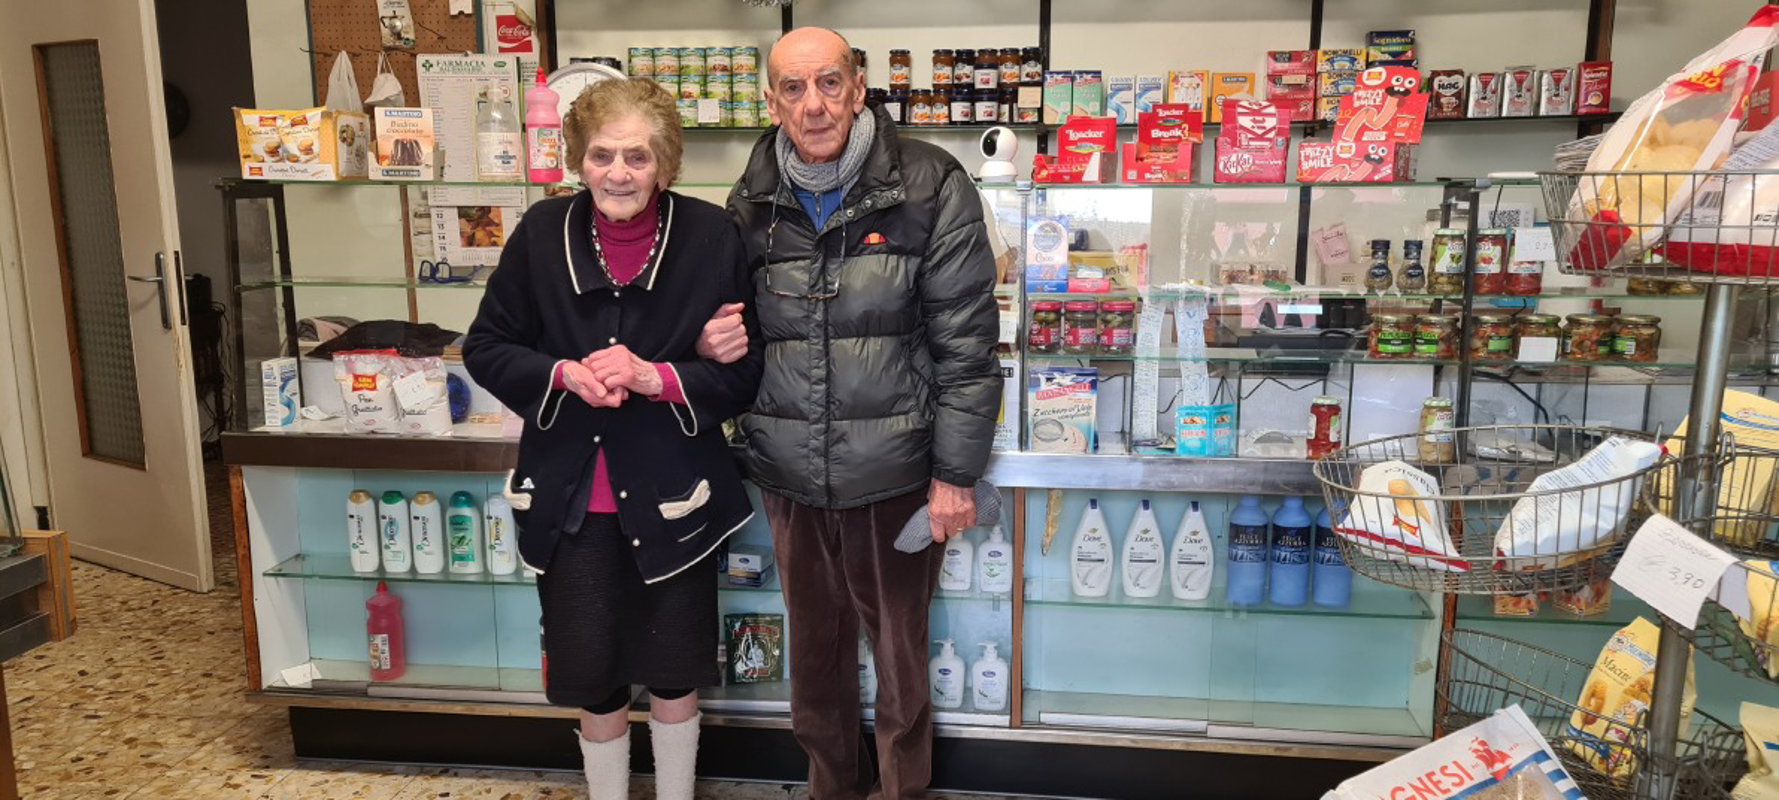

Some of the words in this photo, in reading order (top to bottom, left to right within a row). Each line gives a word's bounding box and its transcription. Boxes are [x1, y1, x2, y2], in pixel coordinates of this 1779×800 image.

[436, 60, 486, 68] FARMACIA
[1066, 130, 1105, 141] Loacker
[1151, 128, 1182, 139] Break
[1083, 534, 1102, 542] Dove
[1134, 534, 1154, 543] Dove
[1183, 536, 1204, 544] Dove
[1668, 566, 1705, 589] 3,90
[1380, 759, 1476, 800] GNESI
